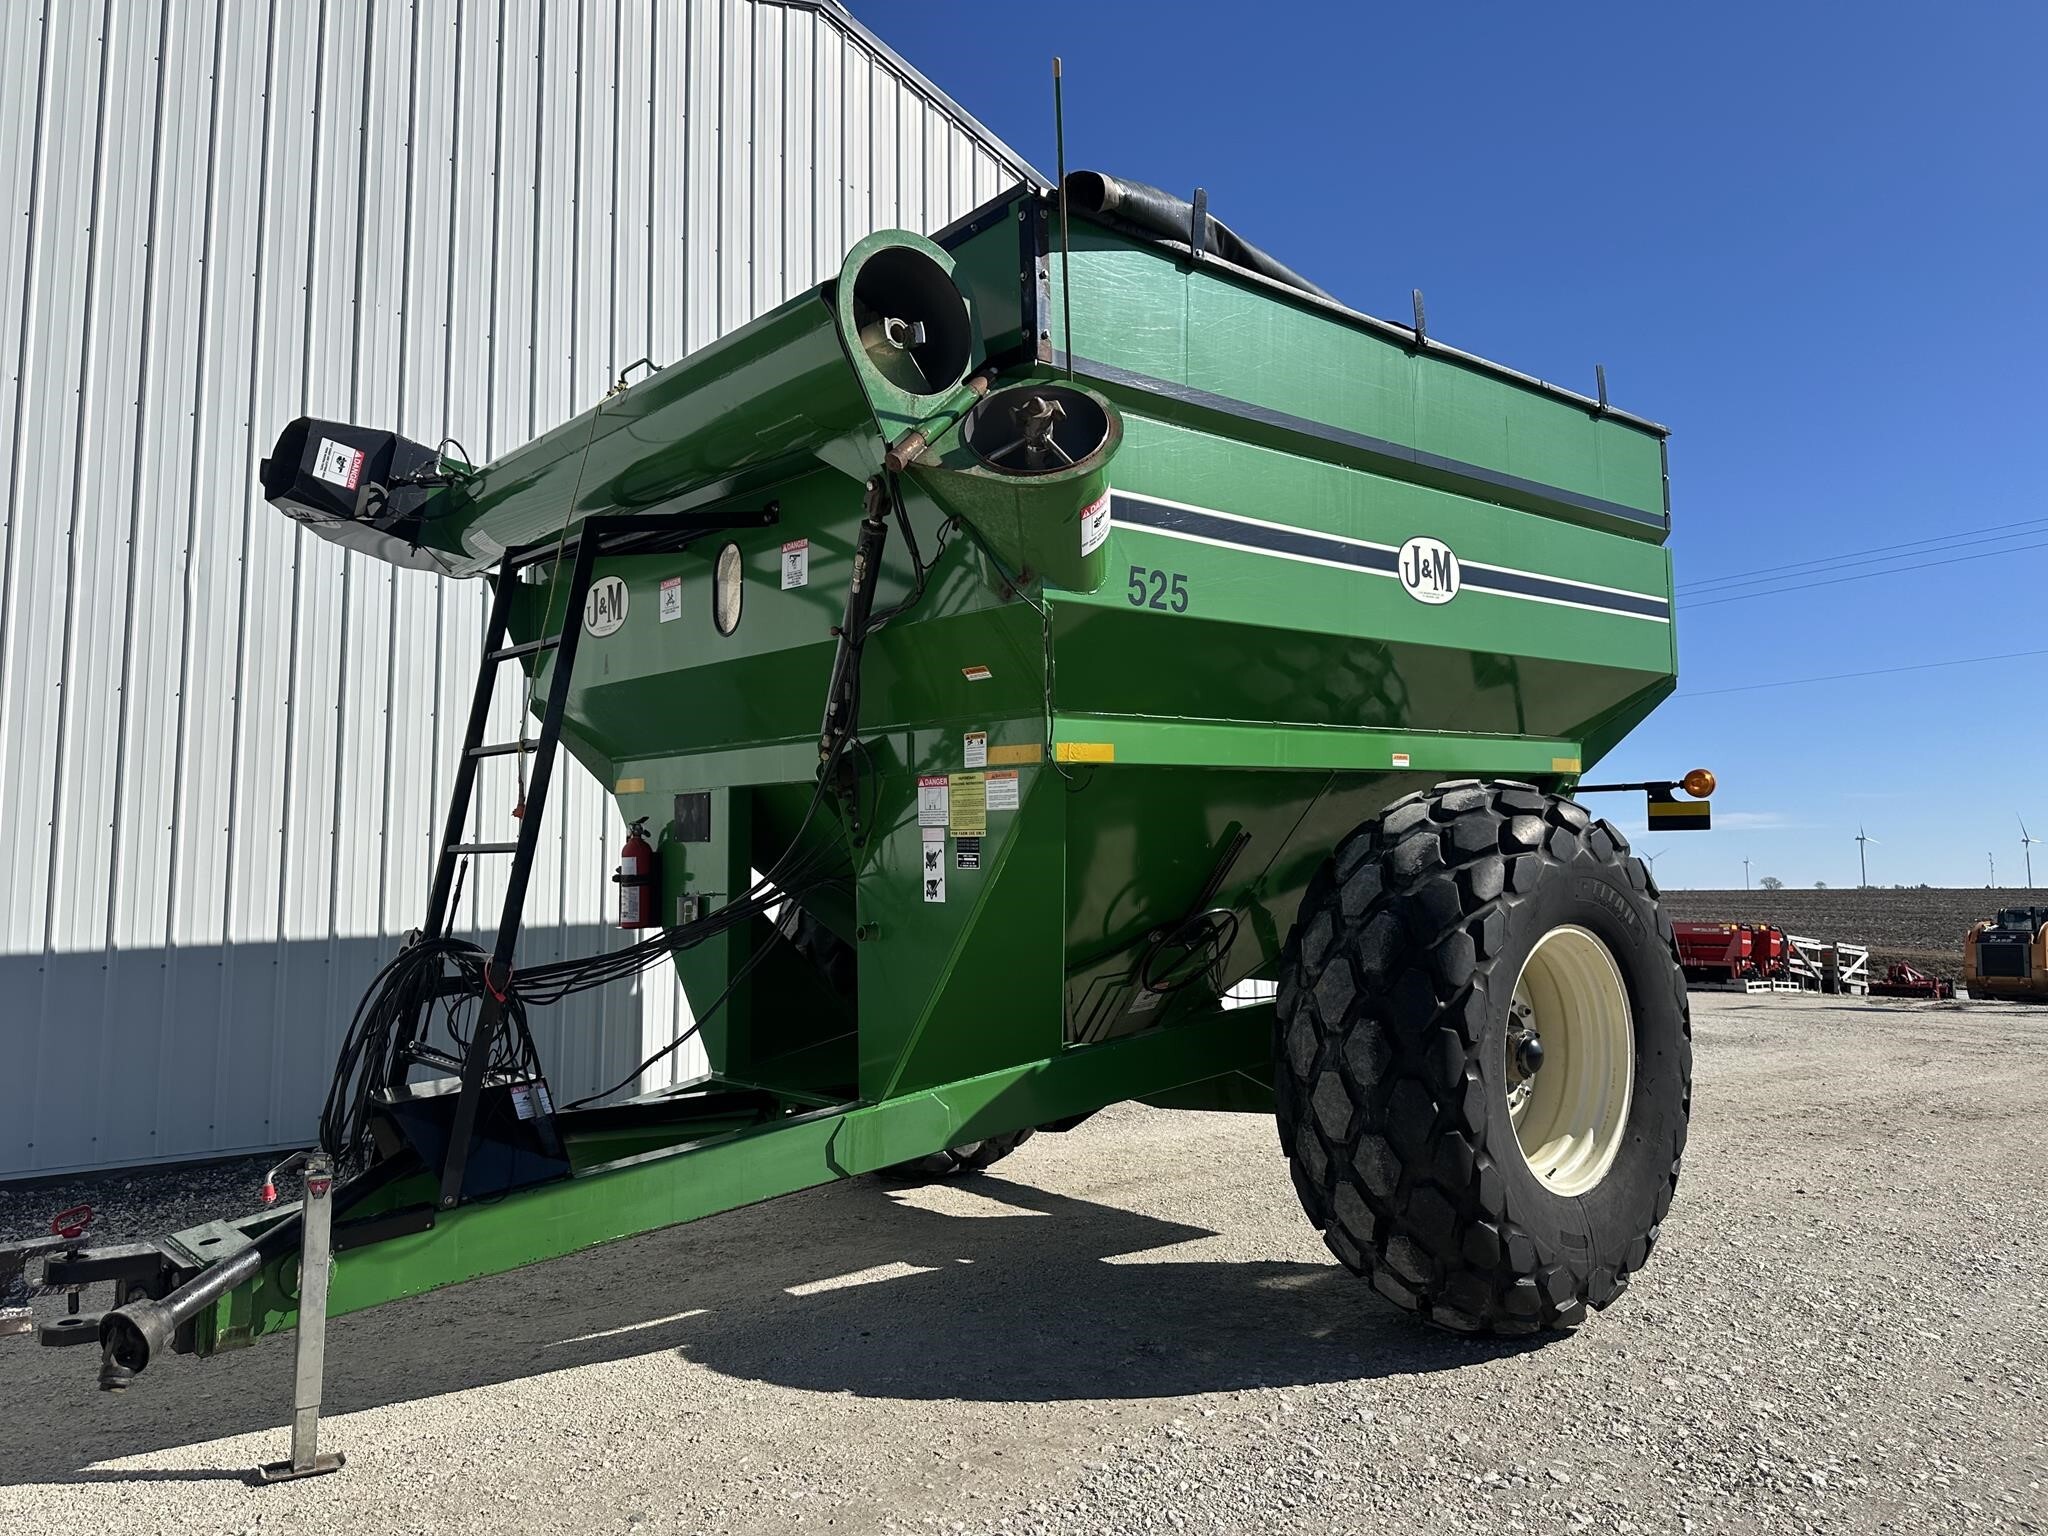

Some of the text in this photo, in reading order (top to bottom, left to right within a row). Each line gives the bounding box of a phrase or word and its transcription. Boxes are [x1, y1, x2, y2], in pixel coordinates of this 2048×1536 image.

[347, 459, 361, 491] DANGER
[787, 540, 808, 551] DANGER
[1127, 565, 1189, 613] 525
[1403, 545, 1453, 593] J&M
[586, 581, 623, 628] J&M
[925, 777, 948, 786] DANGER
[1592, 880, 1637, 925] TITAN
